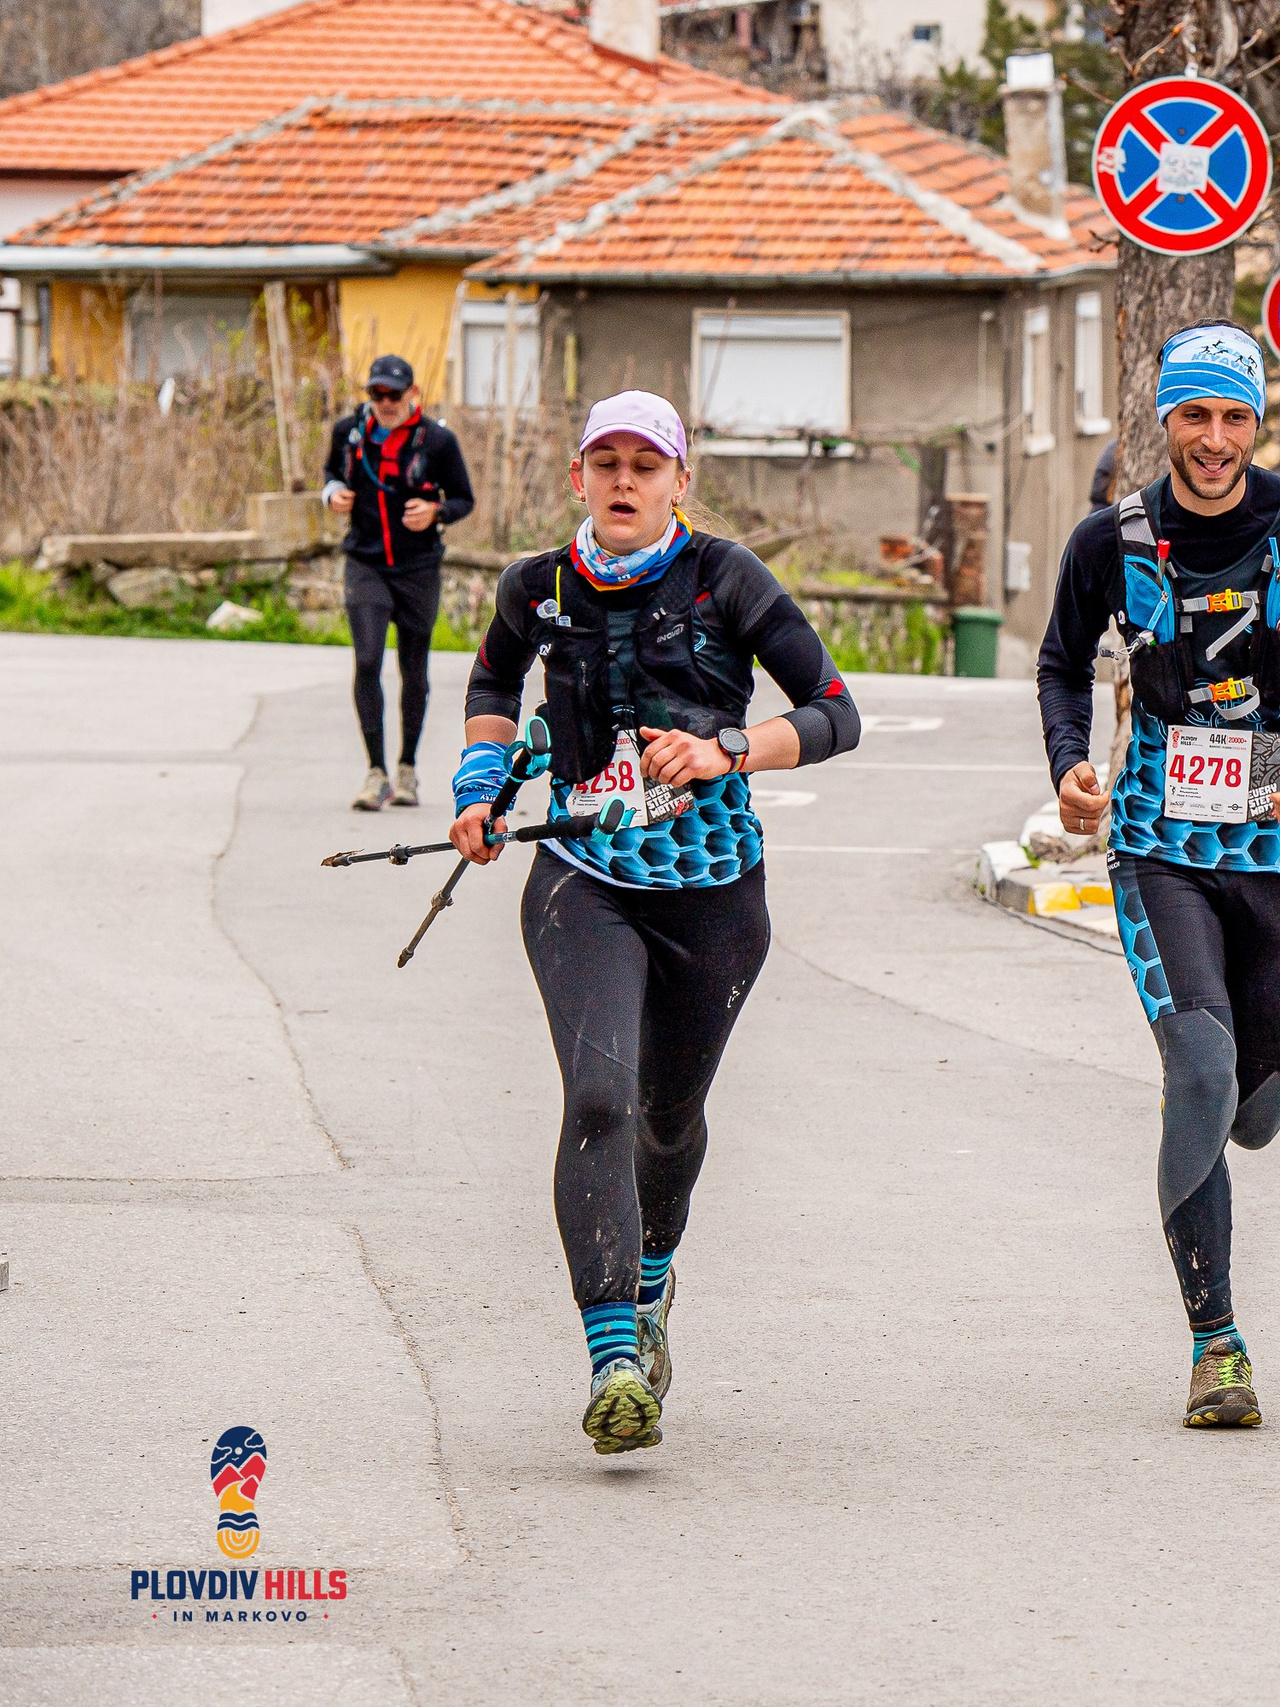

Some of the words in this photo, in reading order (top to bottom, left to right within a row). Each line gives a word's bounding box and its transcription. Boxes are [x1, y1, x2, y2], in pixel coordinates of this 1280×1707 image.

[1209, 733, 1227, 745] 44K
[1168, 754, 1242, 788] 4278
[646, 792, 671, 811] STEP
